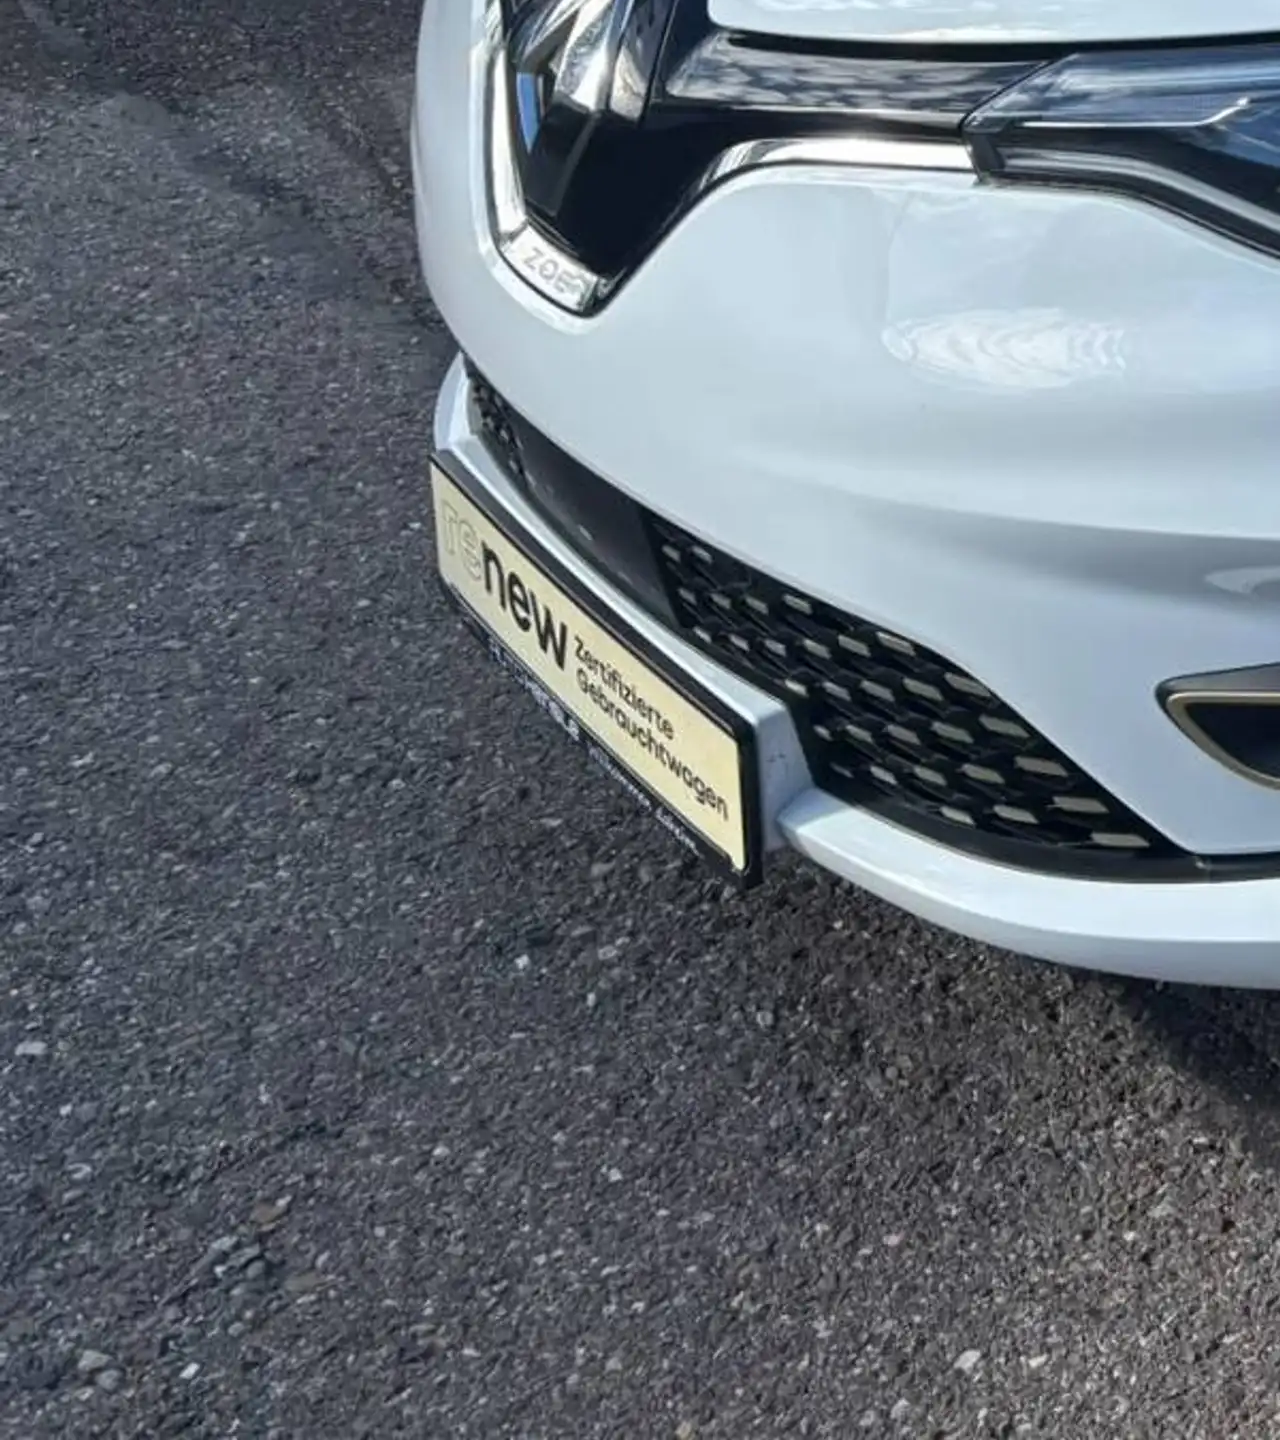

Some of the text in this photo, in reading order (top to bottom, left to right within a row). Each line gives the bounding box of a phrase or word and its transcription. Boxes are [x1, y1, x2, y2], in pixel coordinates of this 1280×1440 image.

[441, 500, 568, 672] renew
[574, 635, 675, 741] Zertifizierte
[576, 667, 729, 822] Gebrauchtwagen
